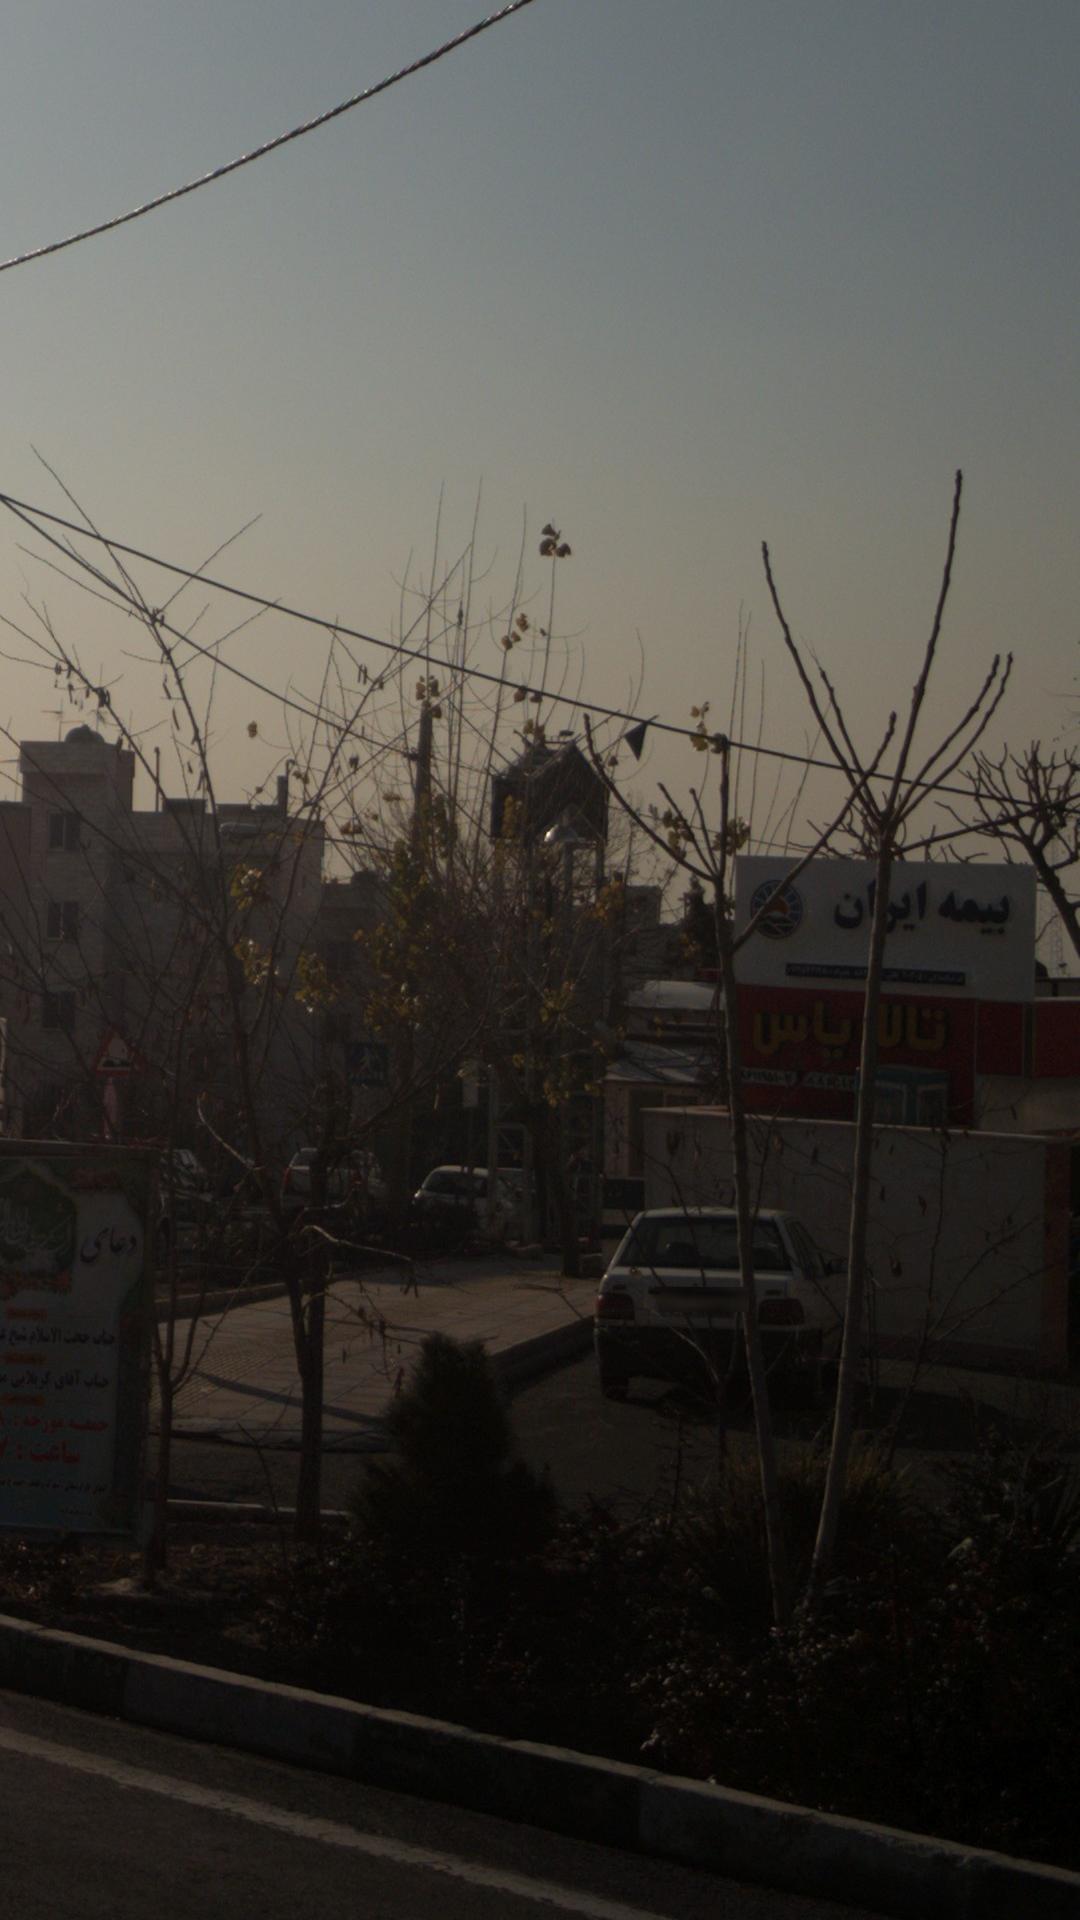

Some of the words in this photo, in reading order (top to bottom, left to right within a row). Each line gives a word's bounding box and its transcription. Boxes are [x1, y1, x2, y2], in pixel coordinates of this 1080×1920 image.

[938, 889, 1010, 935] بیمه
[752, 999, 852, 1057] یاس
[864, 1002, 948, 1052] تالا
[80, 1226, 138, 1264] دعای
